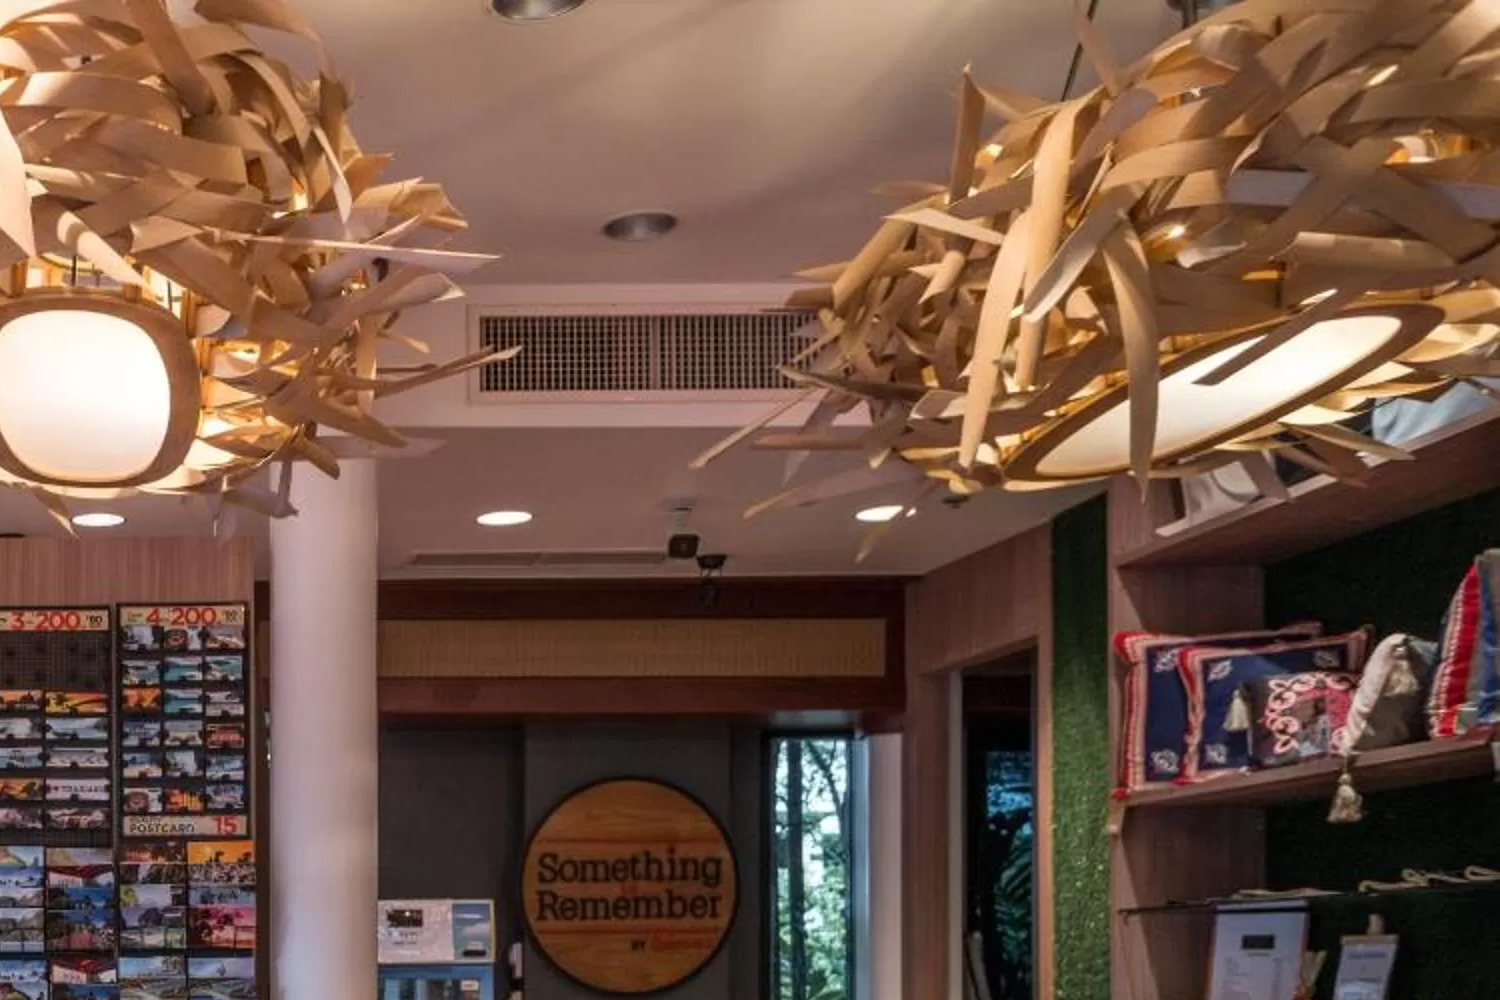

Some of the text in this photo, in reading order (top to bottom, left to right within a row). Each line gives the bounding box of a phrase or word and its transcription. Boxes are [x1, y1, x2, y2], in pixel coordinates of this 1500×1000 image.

[11, 611, 25, 631] 3
[36, 611, 79, 631] 200
[145, 607, 159, 625] 4
[169, 607, 216, 625] 200
[129, 815, 237, 835] POSTCARD 15
[538, 846, 722, 887] Something
[536, 888, 722, 921] Remember
